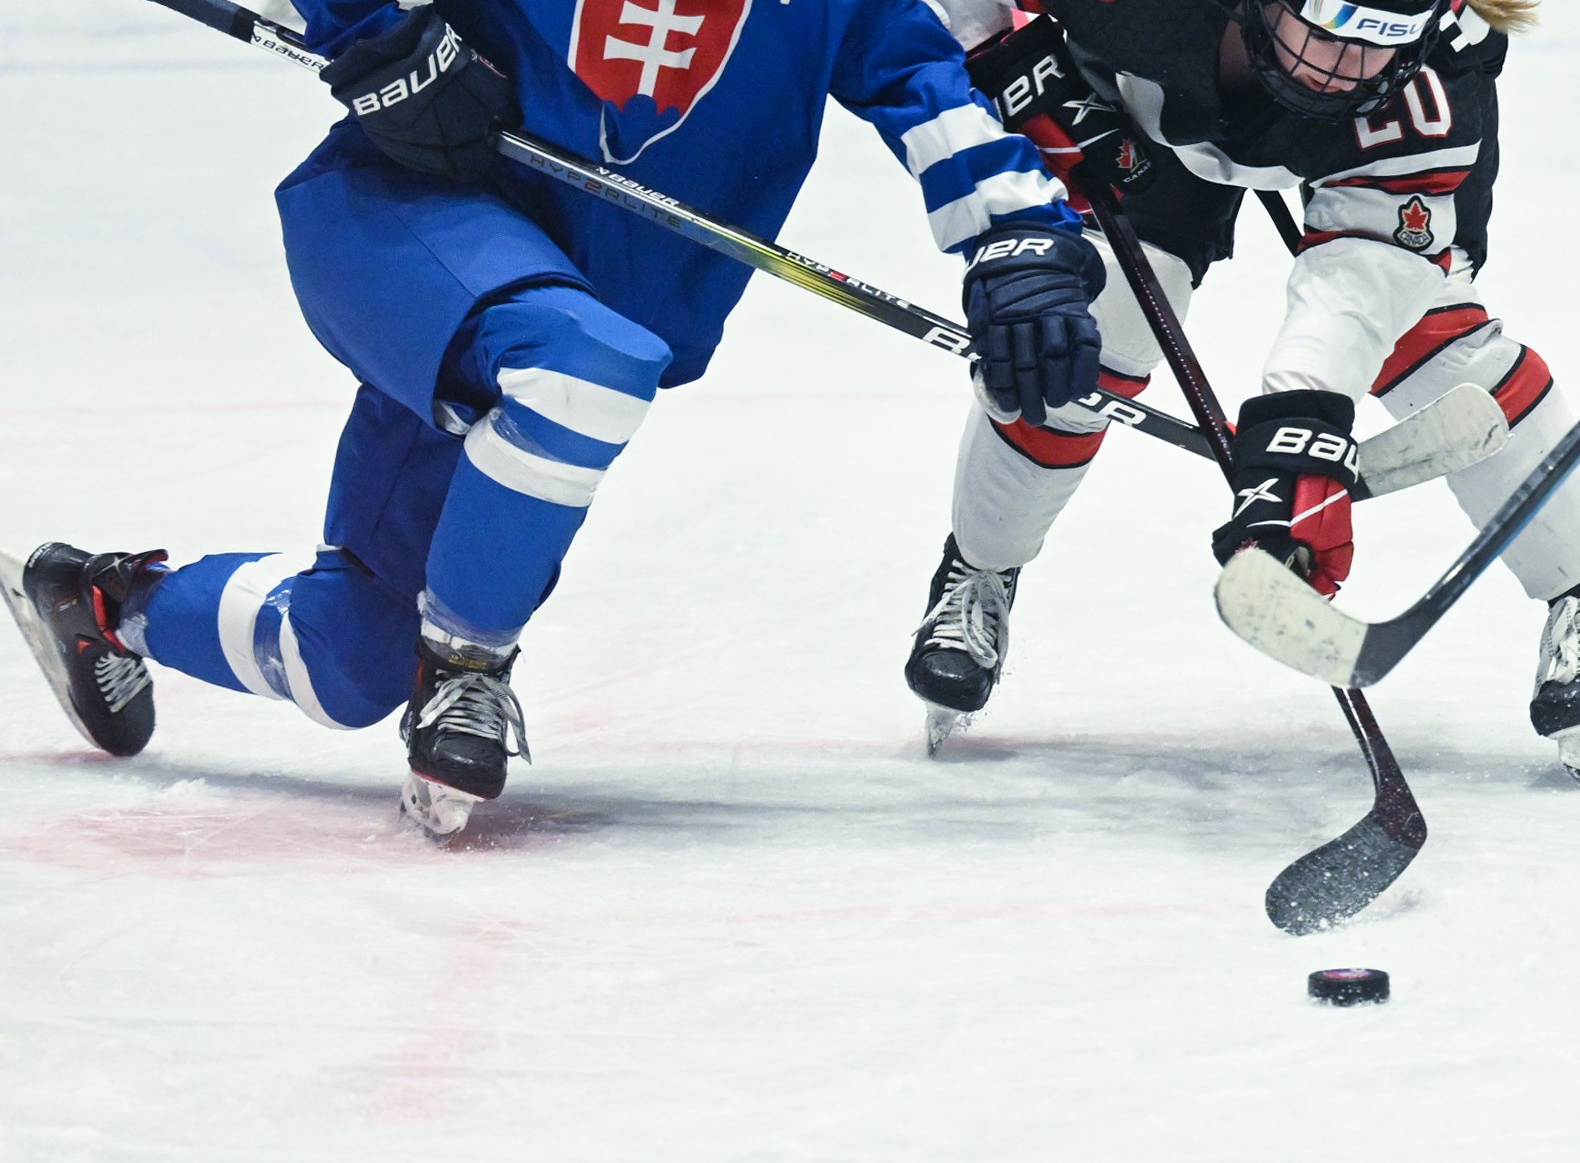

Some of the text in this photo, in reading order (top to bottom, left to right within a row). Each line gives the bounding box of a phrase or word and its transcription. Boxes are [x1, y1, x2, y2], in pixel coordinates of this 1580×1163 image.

[262, 39, 325, 72] BAUER
[353, 23, 463, 116] BAUER
[607, 172, 680, 207] BAUER
